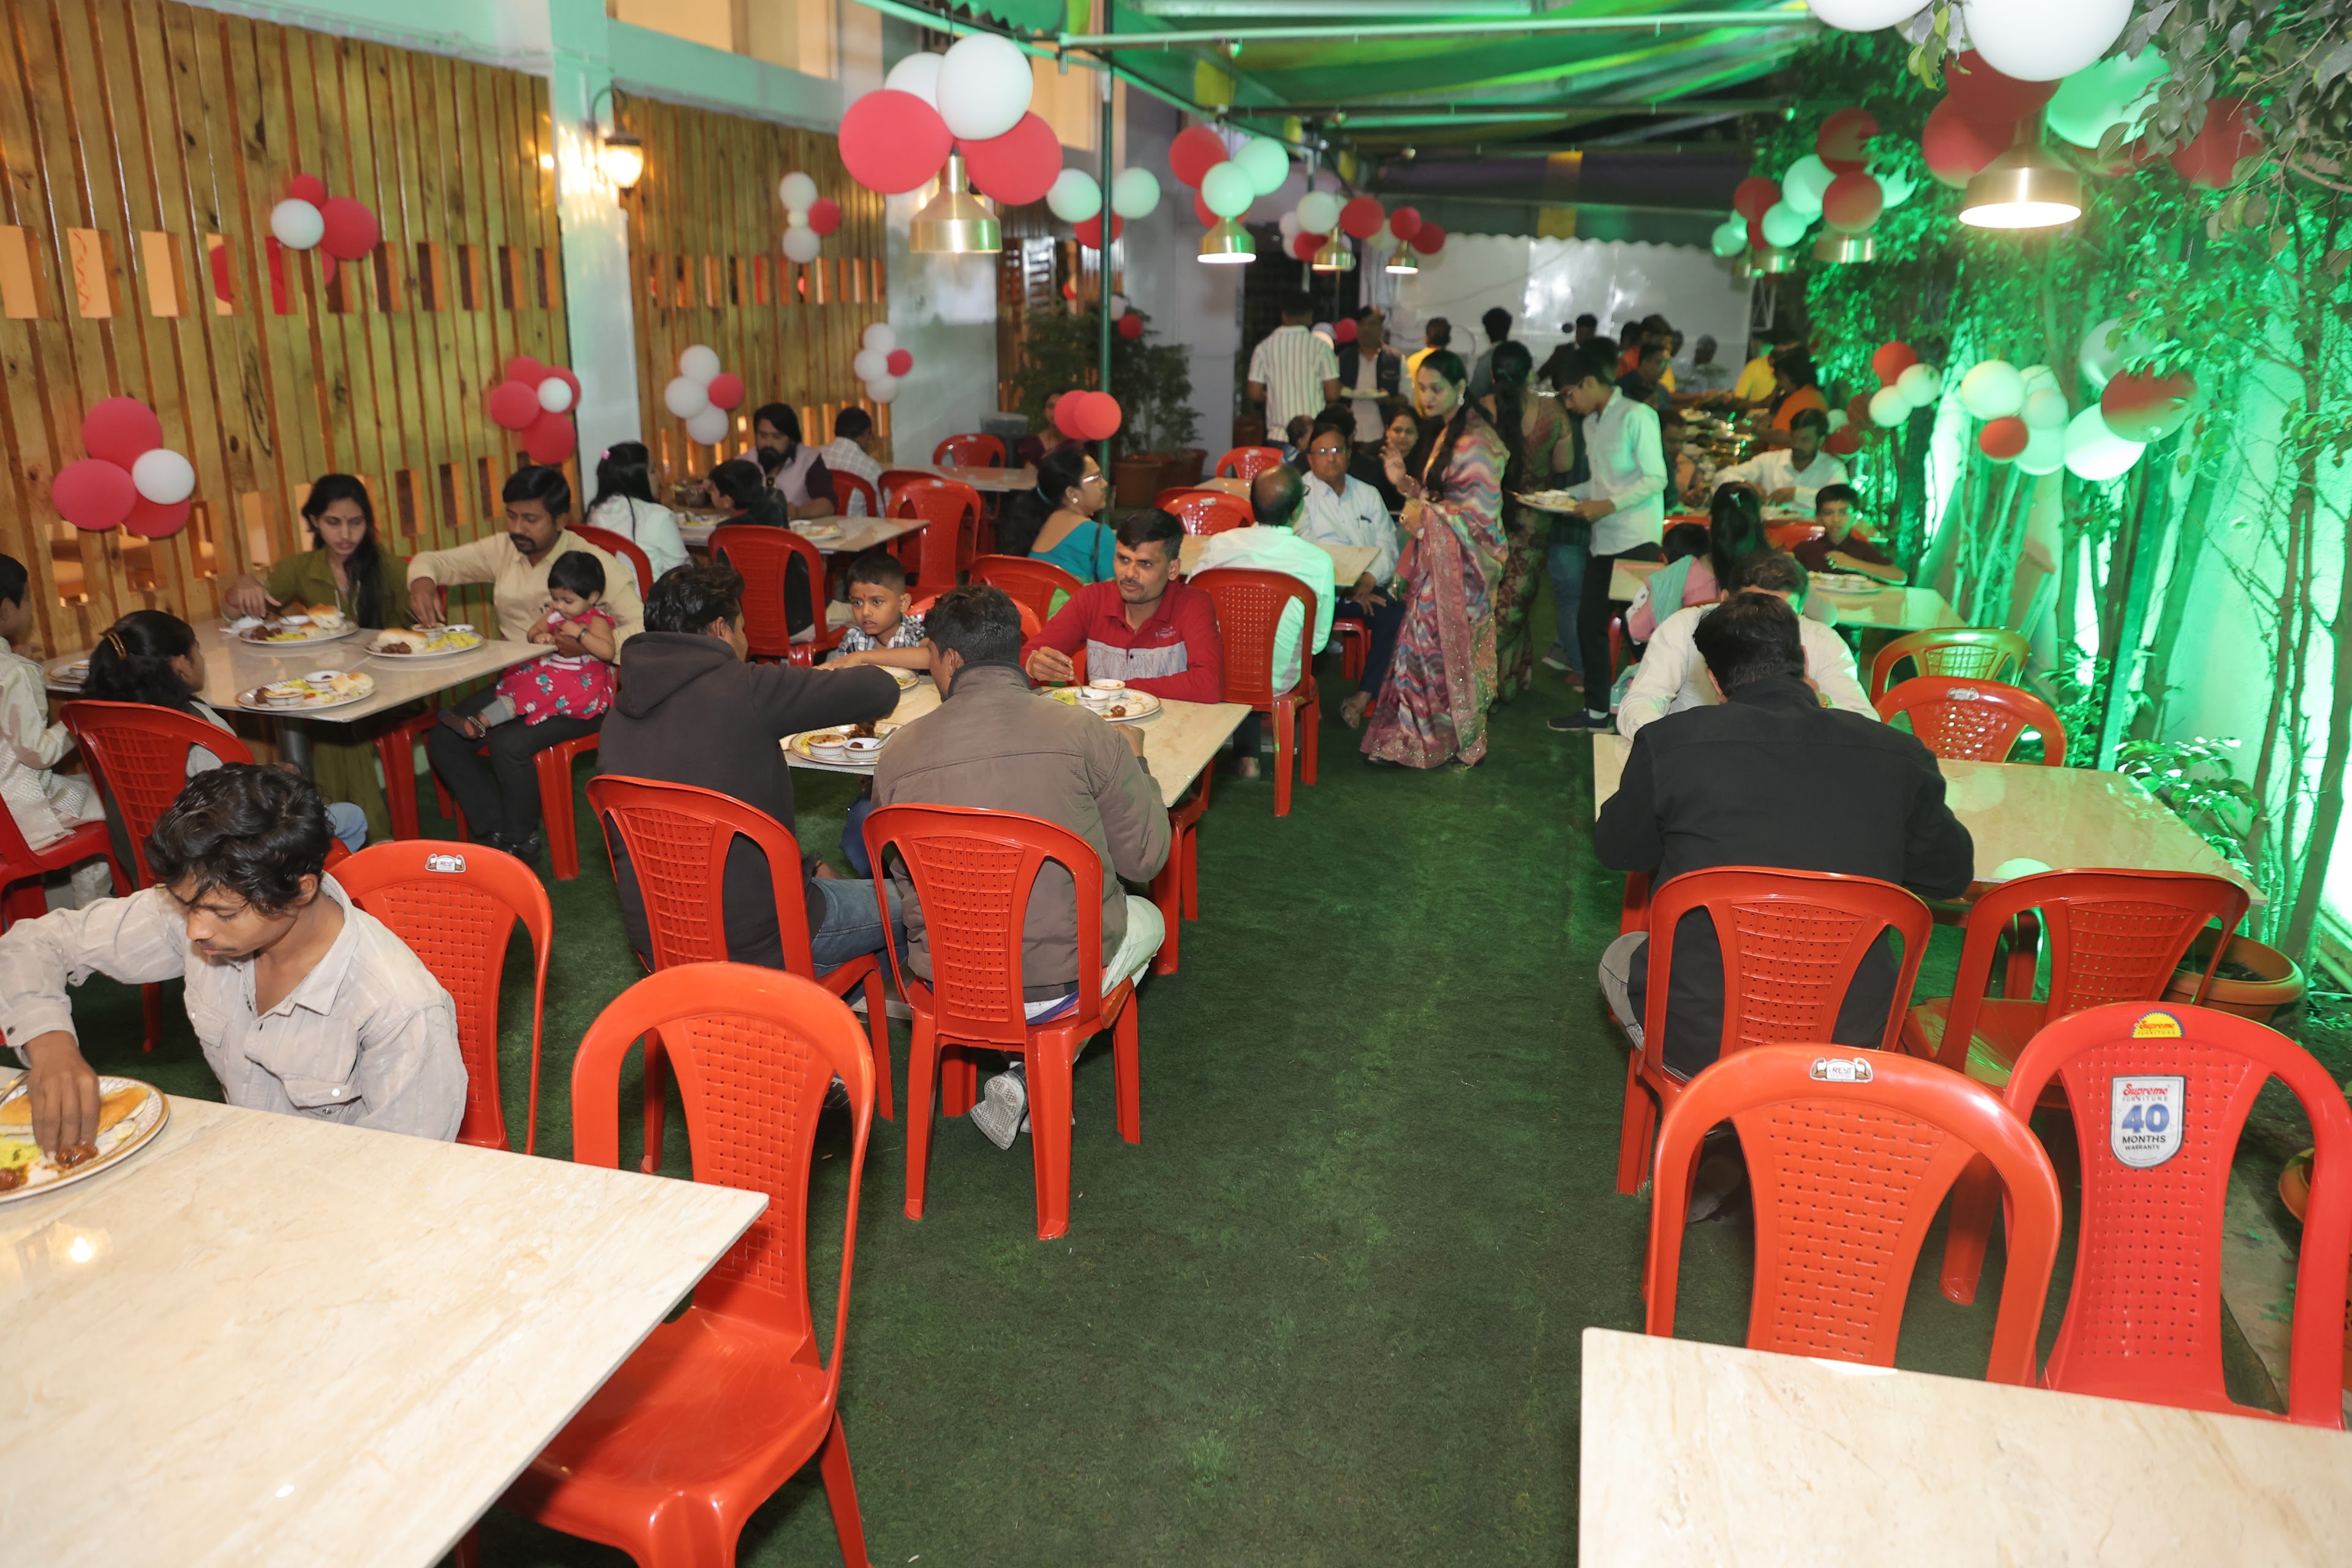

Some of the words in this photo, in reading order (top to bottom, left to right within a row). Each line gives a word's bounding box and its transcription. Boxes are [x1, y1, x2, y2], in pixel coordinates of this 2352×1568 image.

[2139, 1020, 2174, 1031] Supreme
[2123, 1083, 2168, 1098] Supreme
[2122, 1103, 2169, 1134] 40
[2122, 1135, 2166, 1144] MONTHS
